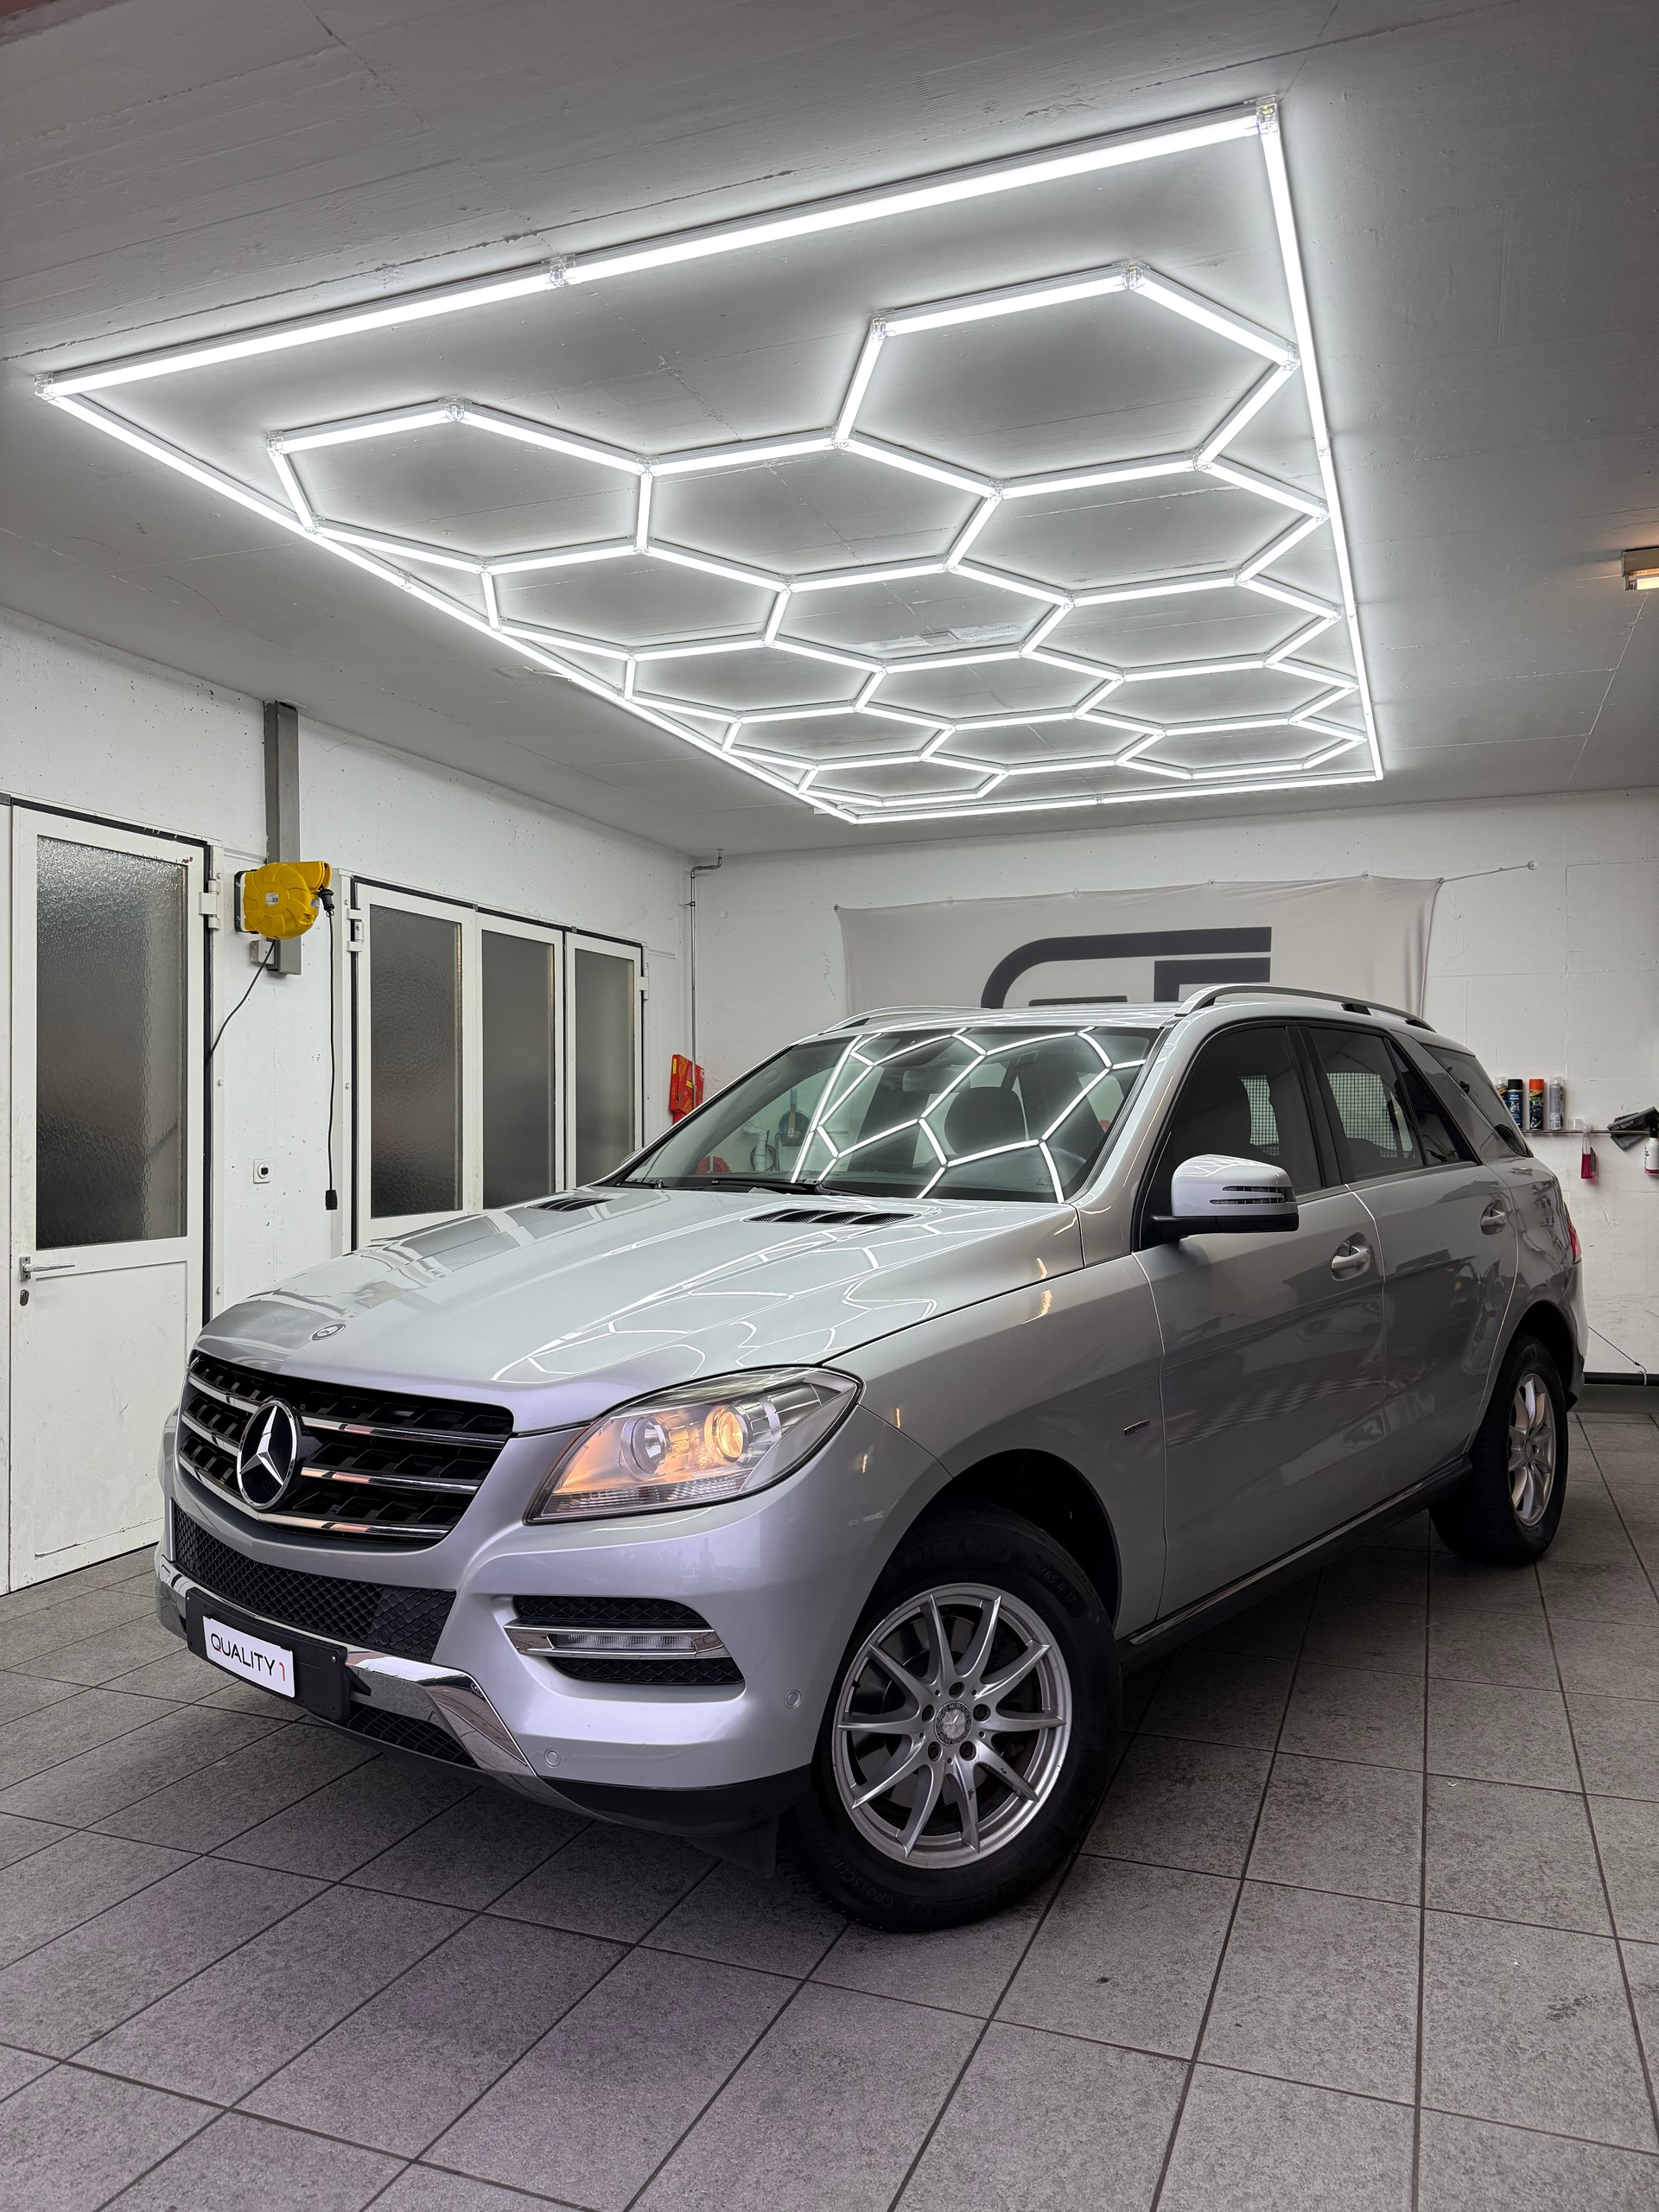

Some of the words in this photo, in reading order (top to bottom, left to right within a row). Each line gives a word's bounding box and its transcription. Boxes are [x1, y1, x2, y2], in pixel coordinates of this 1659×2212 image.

[1057, 1584, 1066, 1593] R
[1065, 1592, 1077, 1603] 17
[211, 1633, 275, 1676] QUALITY
[279, 1662, 285, 1681] 1
